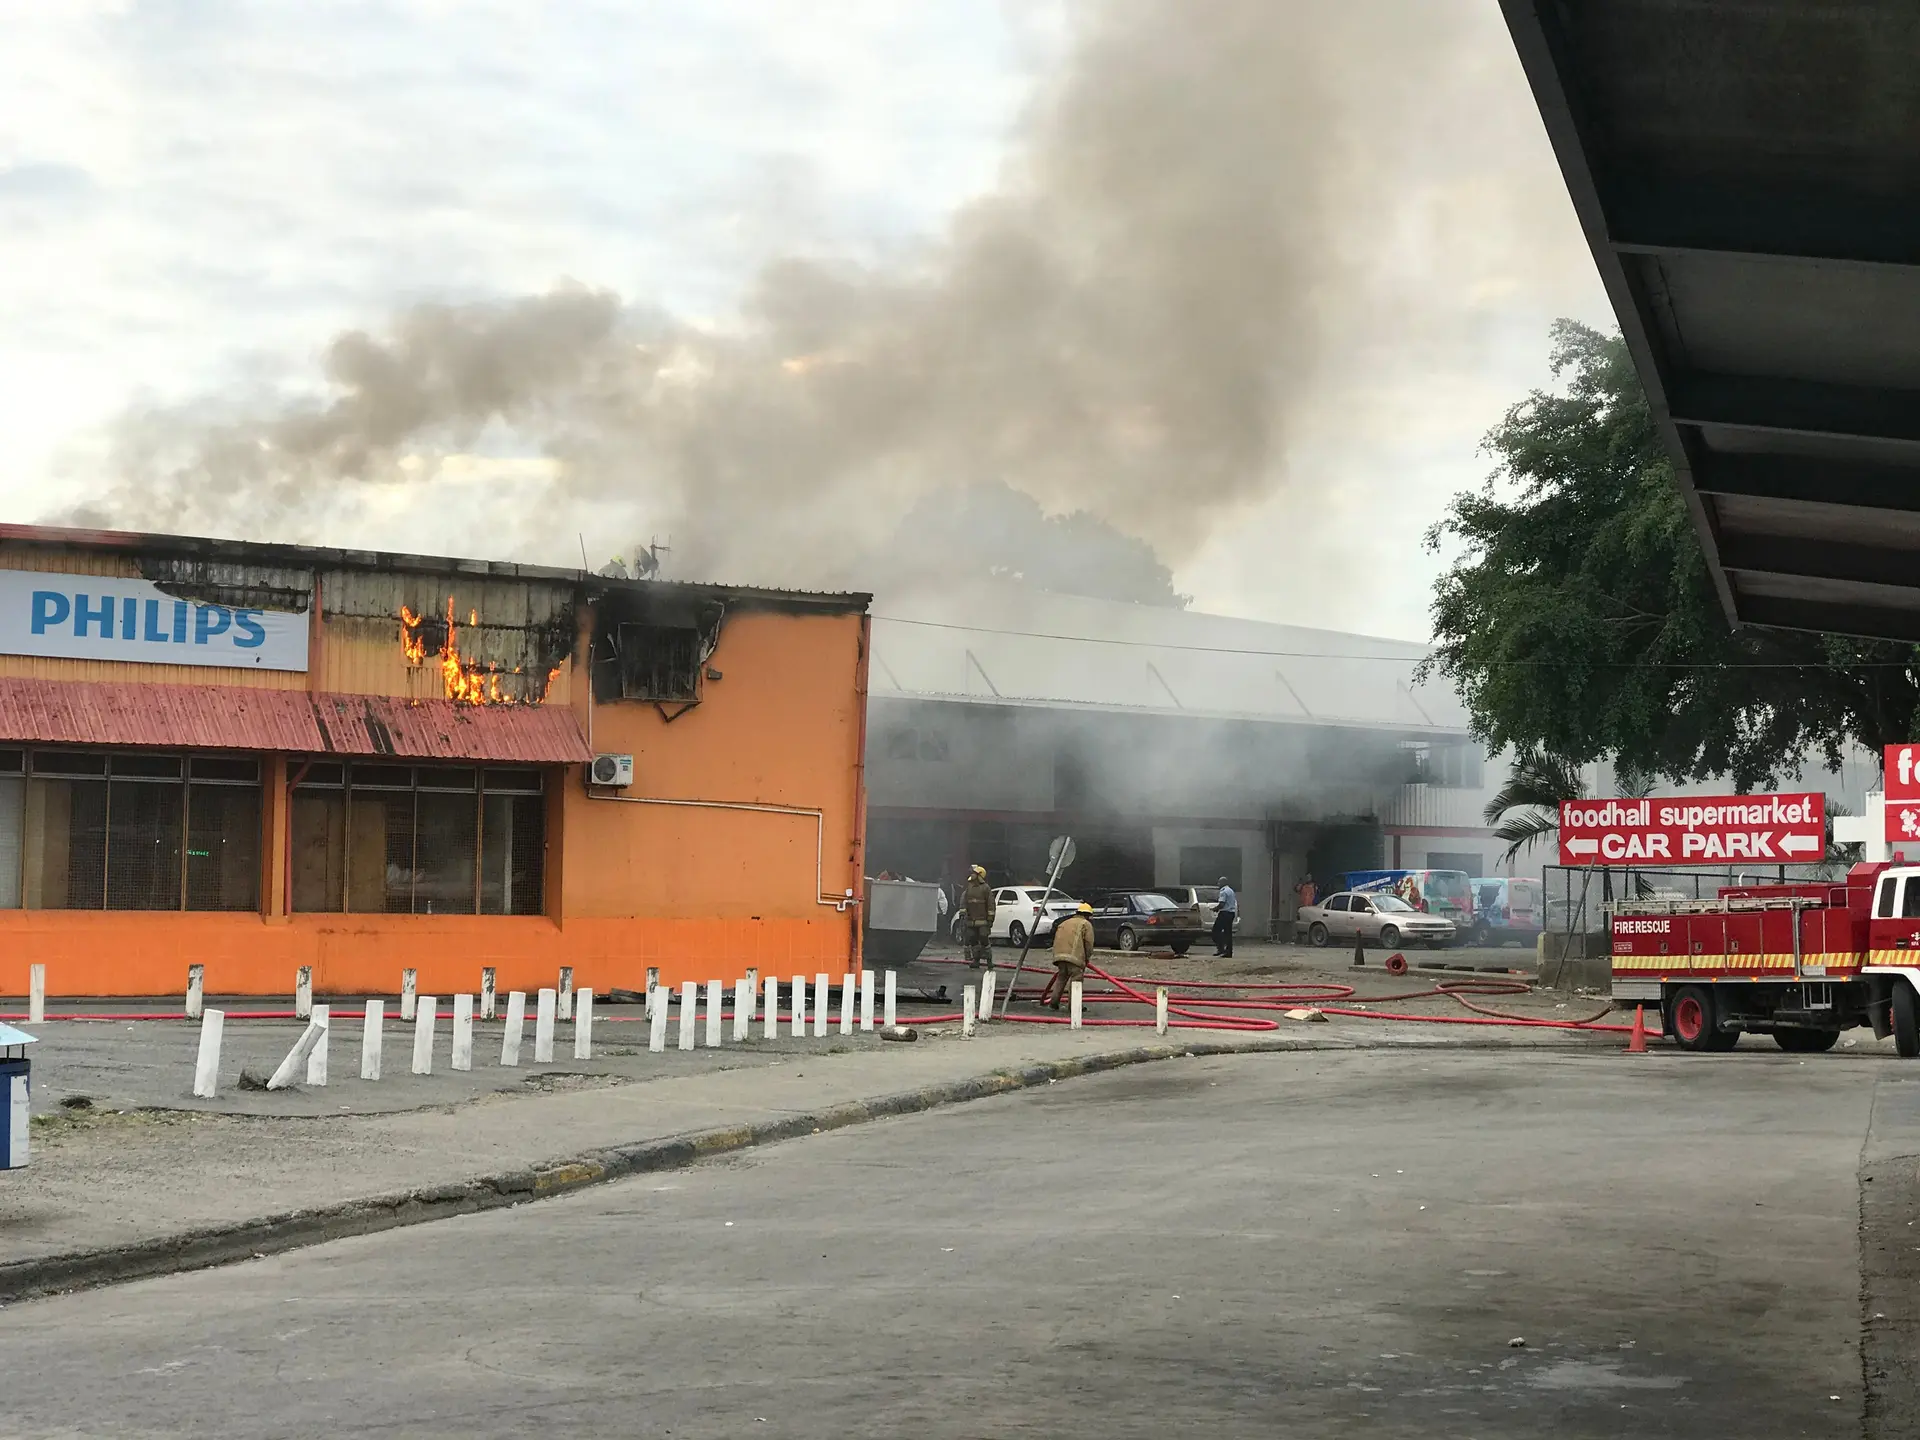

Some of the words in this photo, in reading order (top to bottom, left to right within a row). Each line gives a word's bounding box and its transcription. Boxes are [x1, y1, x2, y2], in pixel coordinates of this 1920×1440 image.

[31, 591, 266, 648] PHILIPS
[1564, 800, 1650, 827] foodhall
[1660, 796, 1818, 832] supermarket.
[1601, 833, 1672, 859] CAR
[1682, 832, 1776, 858] PARK
[1614, 921, 1635, 934] FIRE
[1635, 920, 1671, 933] RESCUE
